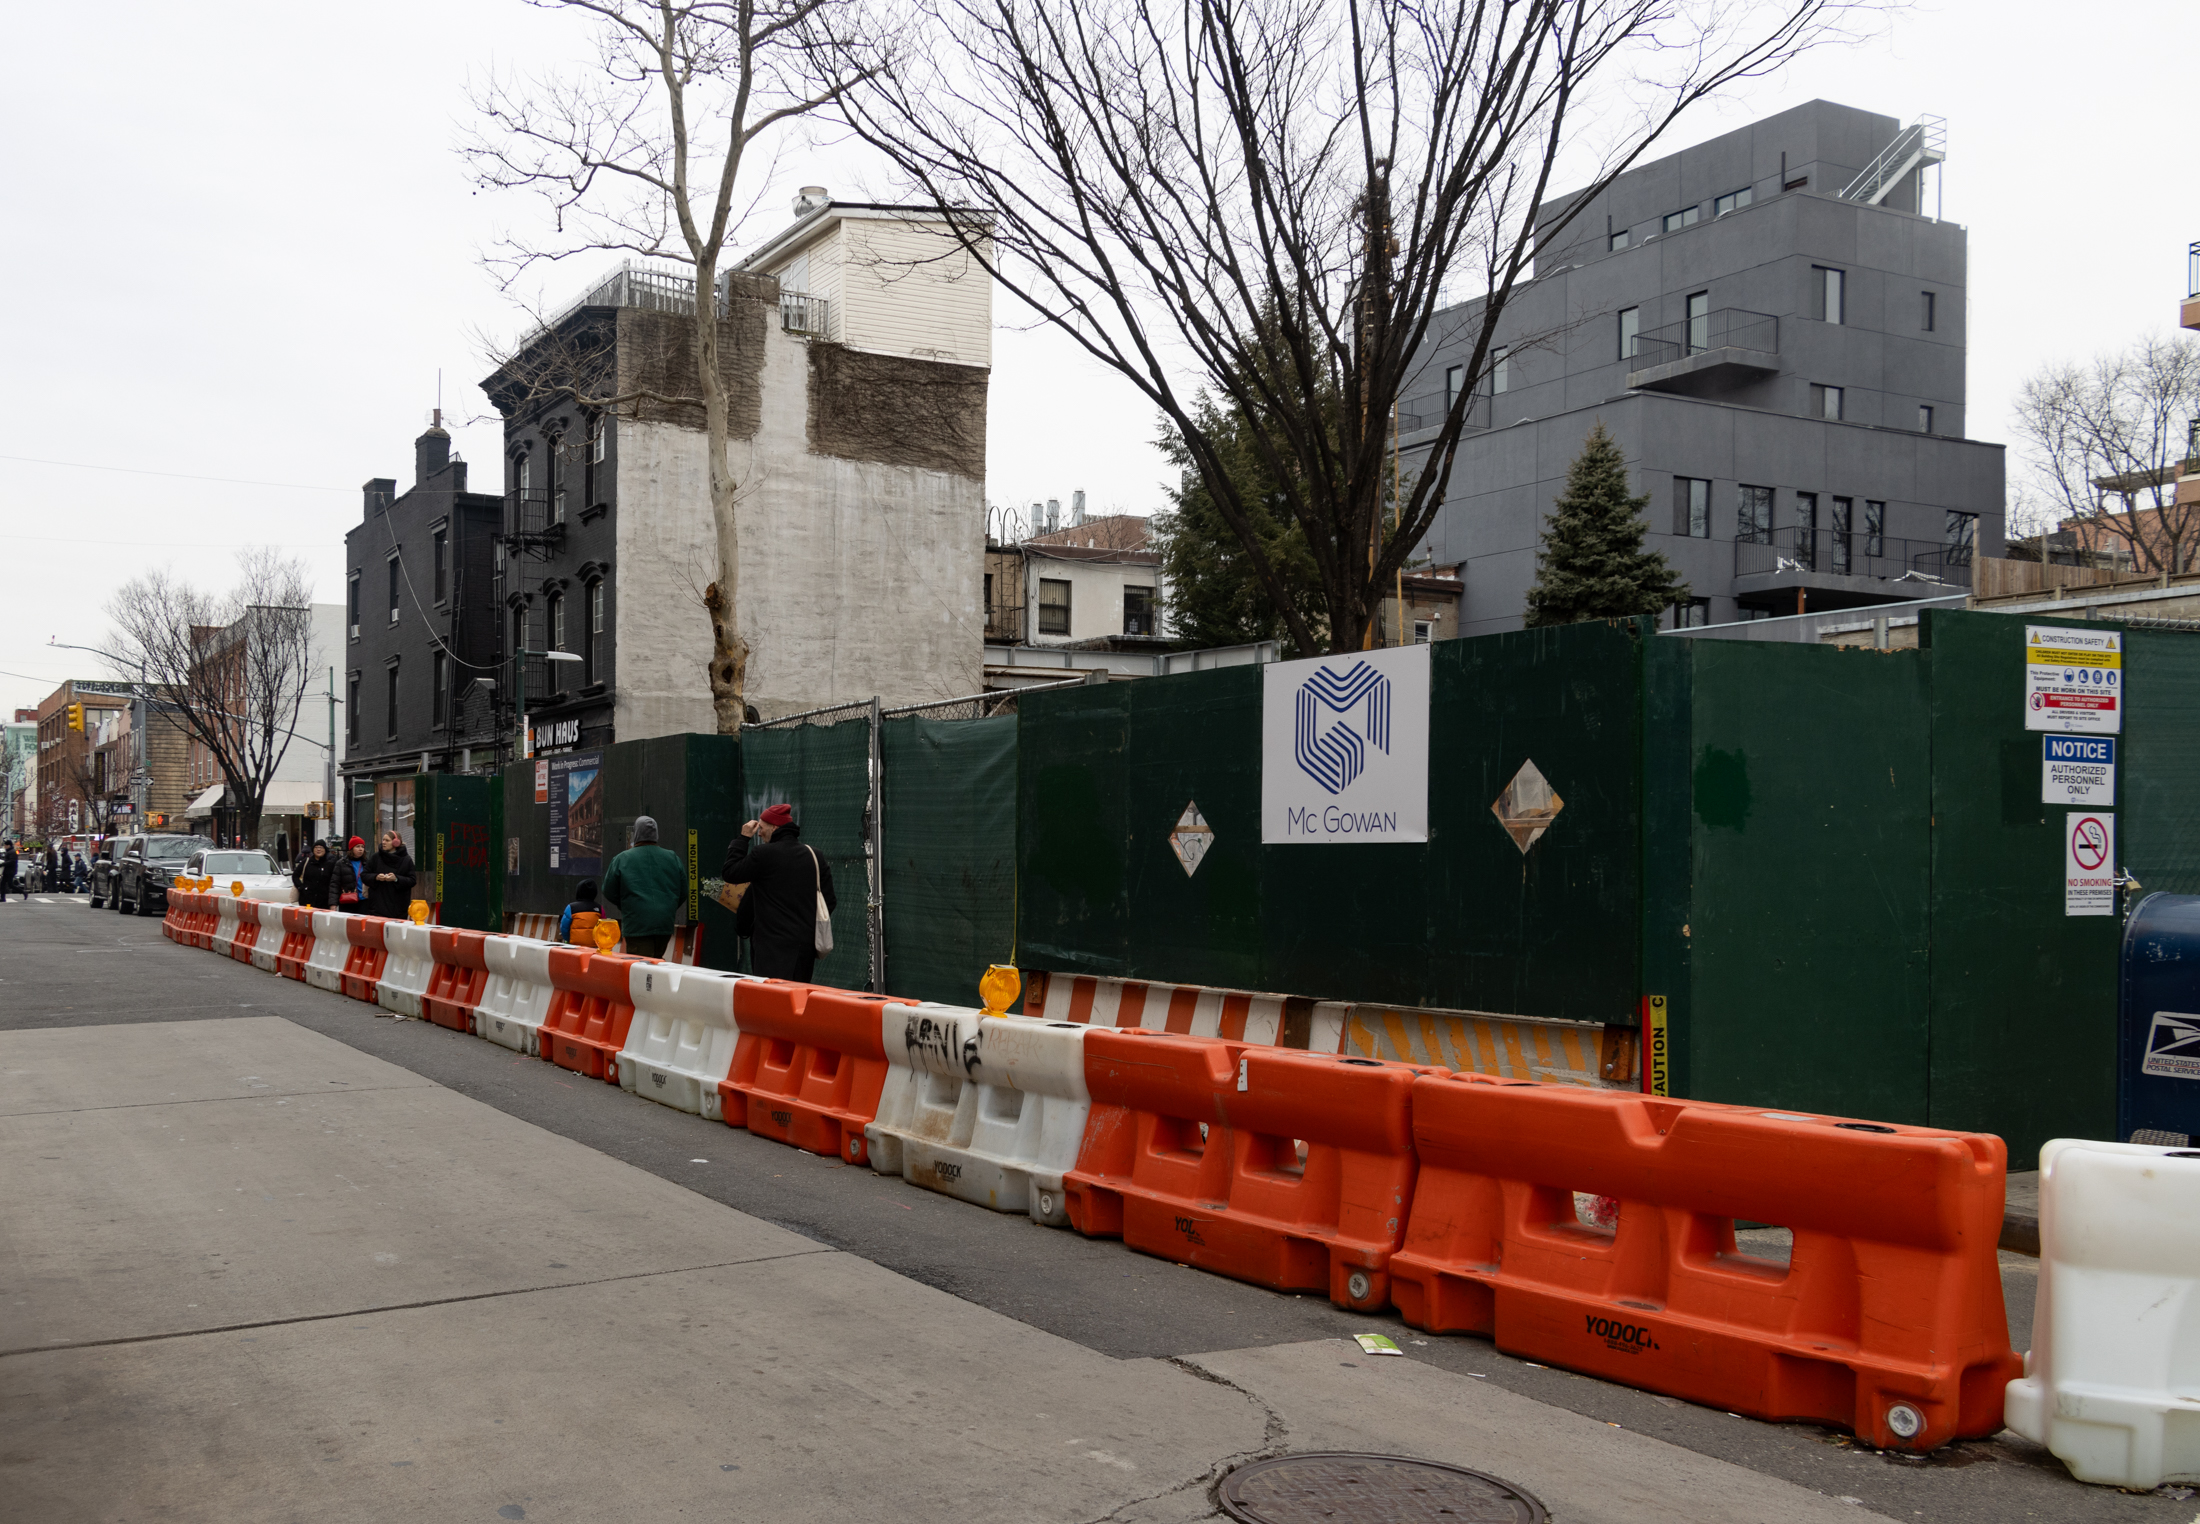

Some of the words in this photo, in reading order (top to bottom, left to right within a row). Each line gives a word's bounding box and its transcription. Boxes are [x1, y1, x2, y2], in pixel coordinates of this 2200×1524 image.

[2042, 635, 2084, 644] CONSTRUCTION
[2084, 638, 2104, 646] SAFETY
[536, 724, 553, 748] BUN
[556, 719, 579, 745] HAUS
[2052, 740, 2107, 759] NOTICE
[551, 761, 561, 770] Work
[579, 755, 599, 766] Commercial
[2051, 764, 2106, 776] AUTHORIZED
[2052, 774, 2105, 786] PERSONNEL
[2067, 785, 2090, 794] ONLY
[451, 822, 490, 843] FREE
[443, 846, 489, 868] CUBA
[2068, 878, 2078, 886] NO
[2080, 878, 2112, 886] SMOKING
[2148, 1057, 2175, 1065] UNITED
[2174, 1067, 2200, 1075] SERVICE
[652, 1072, 667, 1085] YODOCK
[771, 1110, 792, 1123] YODOCK
[934, 1160, 962, 1178] YODOCK
